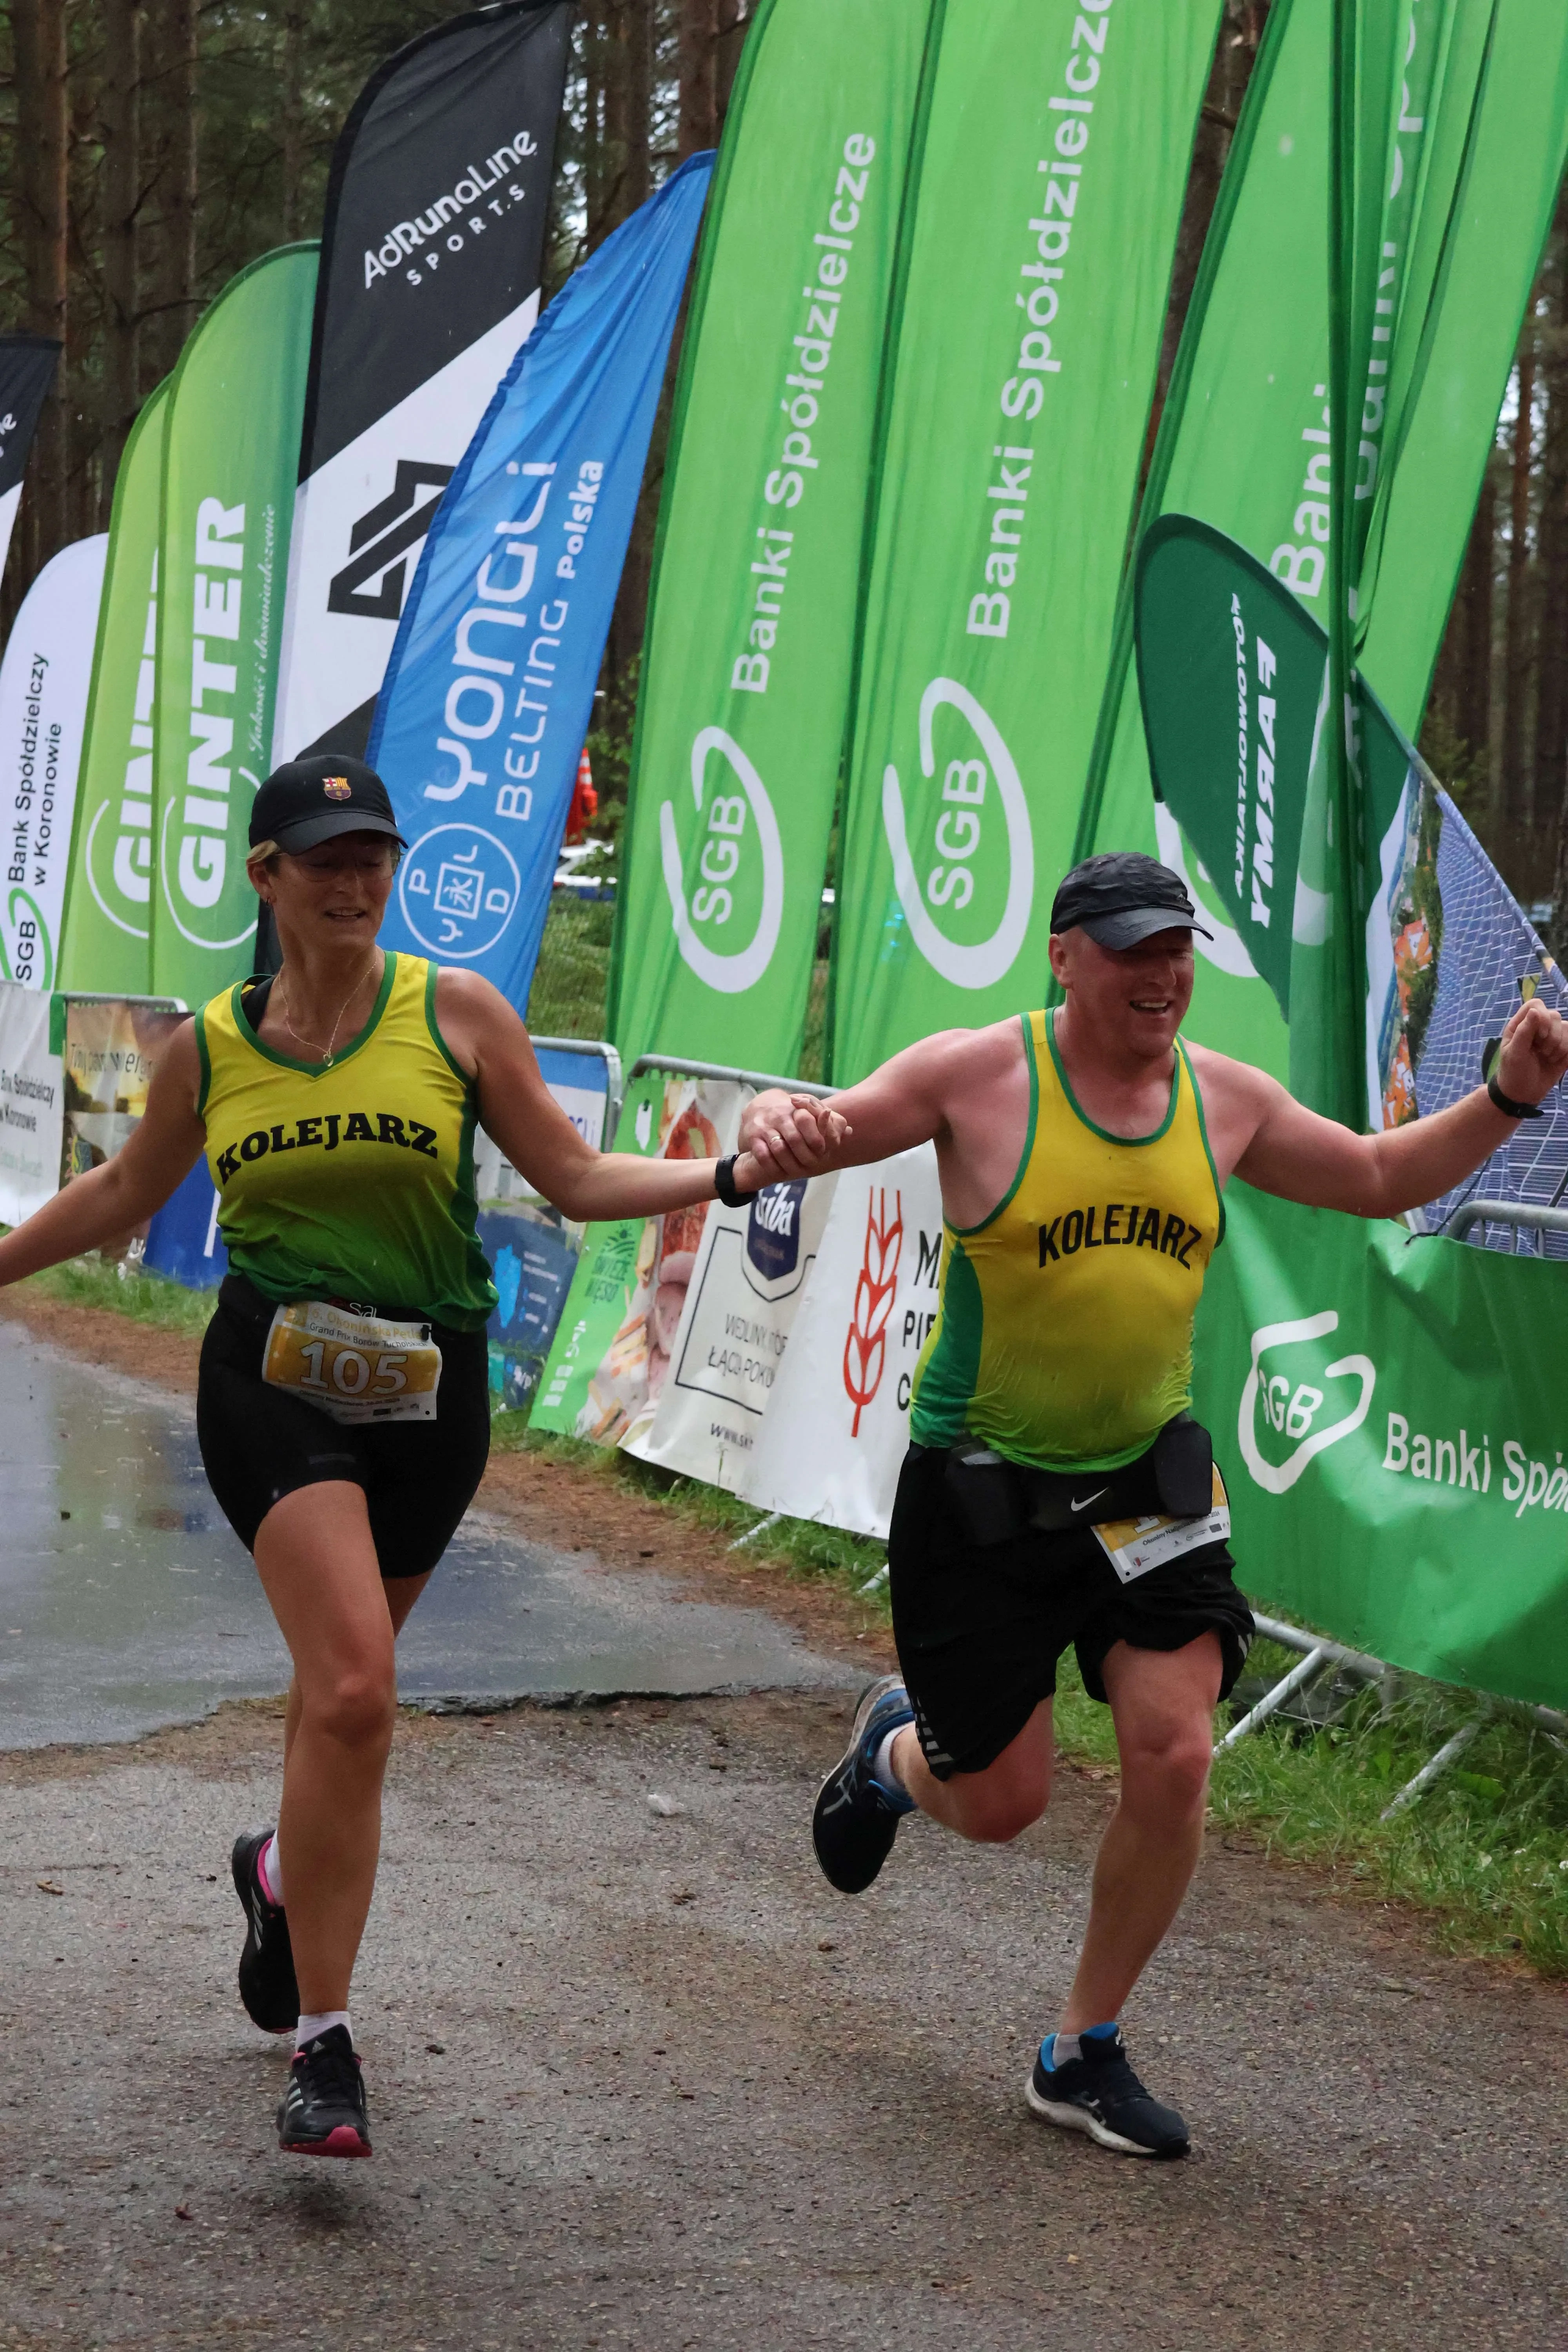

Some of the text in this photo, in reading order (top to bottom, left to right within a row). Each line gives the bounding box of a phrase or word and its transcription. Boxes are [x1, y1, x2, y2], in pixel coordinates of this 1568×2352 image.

[406, 183, 525, 286] SPORTS
[731, 133, 875, 693] Banki Spółdzielcze
[557, 460, 604, 580] Polska
[966, 445, 1035, 638] Banki
[1269, 383, 1330, 598] Bank
[178, 497, 245, 908] GINTER
[8, 652, 49, 883] Bank Spółdzielczy
[34, 723, 62, 886] w Koronowie
[692, 795, 747, 924] SGB
[928, 759, 988, 910] SGB
[16, 920, 36, 981] SGB
[216, 1112, 438, 1185] KOLEJARZ
[1039, 1204, 1201, 1270] KOLEJARZ
[299, 1341, 408, 1395] 105
[310, 1323, 335, 1336] Grand
[337, 1330, 351, 1341] Prix
[1382, 1412, 1491, 1493] Banki
